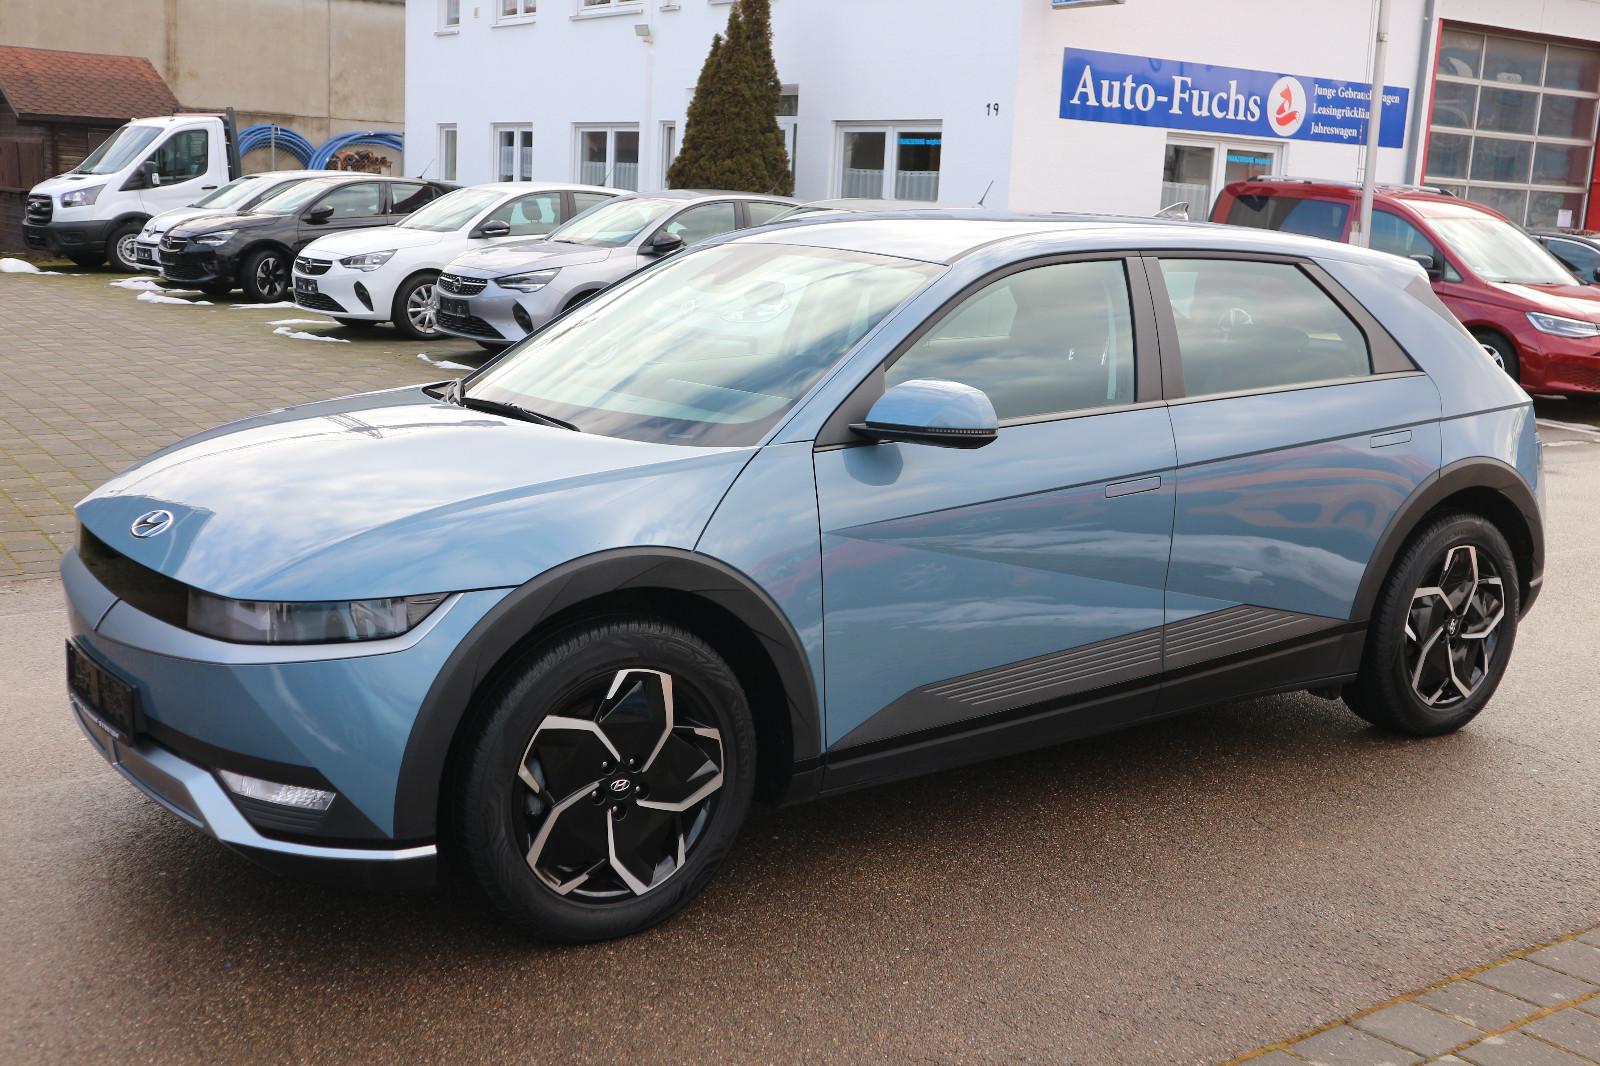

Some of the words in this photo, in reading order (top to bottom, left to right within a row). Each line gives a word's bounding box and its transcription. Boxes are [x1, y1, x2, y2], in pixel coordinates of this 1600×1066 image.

[1070, 64, 1261, 122] Auto-Fuchs
[1314, 84, 1337, 99] Junge
[1338, 86, 1400, 106] Gebraucagen
[986, 103, 999, 117] 19
[1312, 103, 1370, 119] Leasingrückläu
[1310, 122, 1358, 138] Jahreswagen
